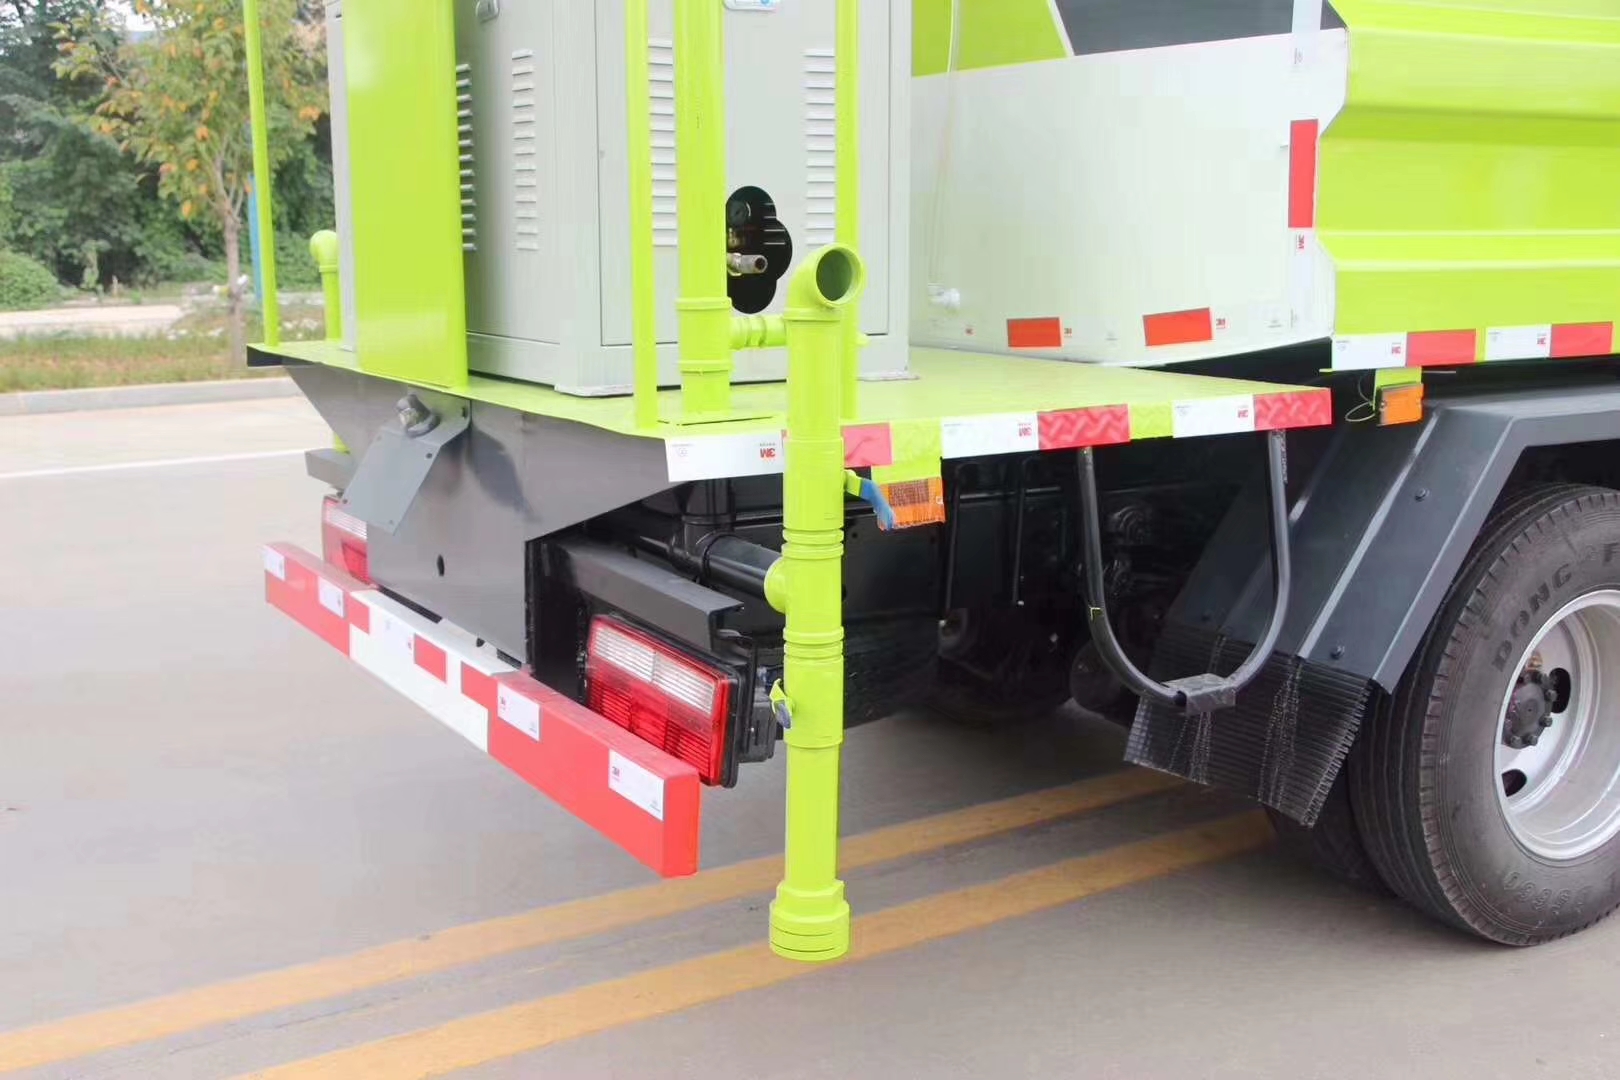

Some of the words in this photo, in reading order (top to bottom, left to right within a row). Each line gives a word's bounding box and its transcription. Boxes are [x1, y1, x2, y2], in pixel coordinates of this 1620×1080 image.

[1019, 427, 1032, 437] 3M
[760, 447, 776, 458] 3M
[1492, 563, 1573, 672] DONG
